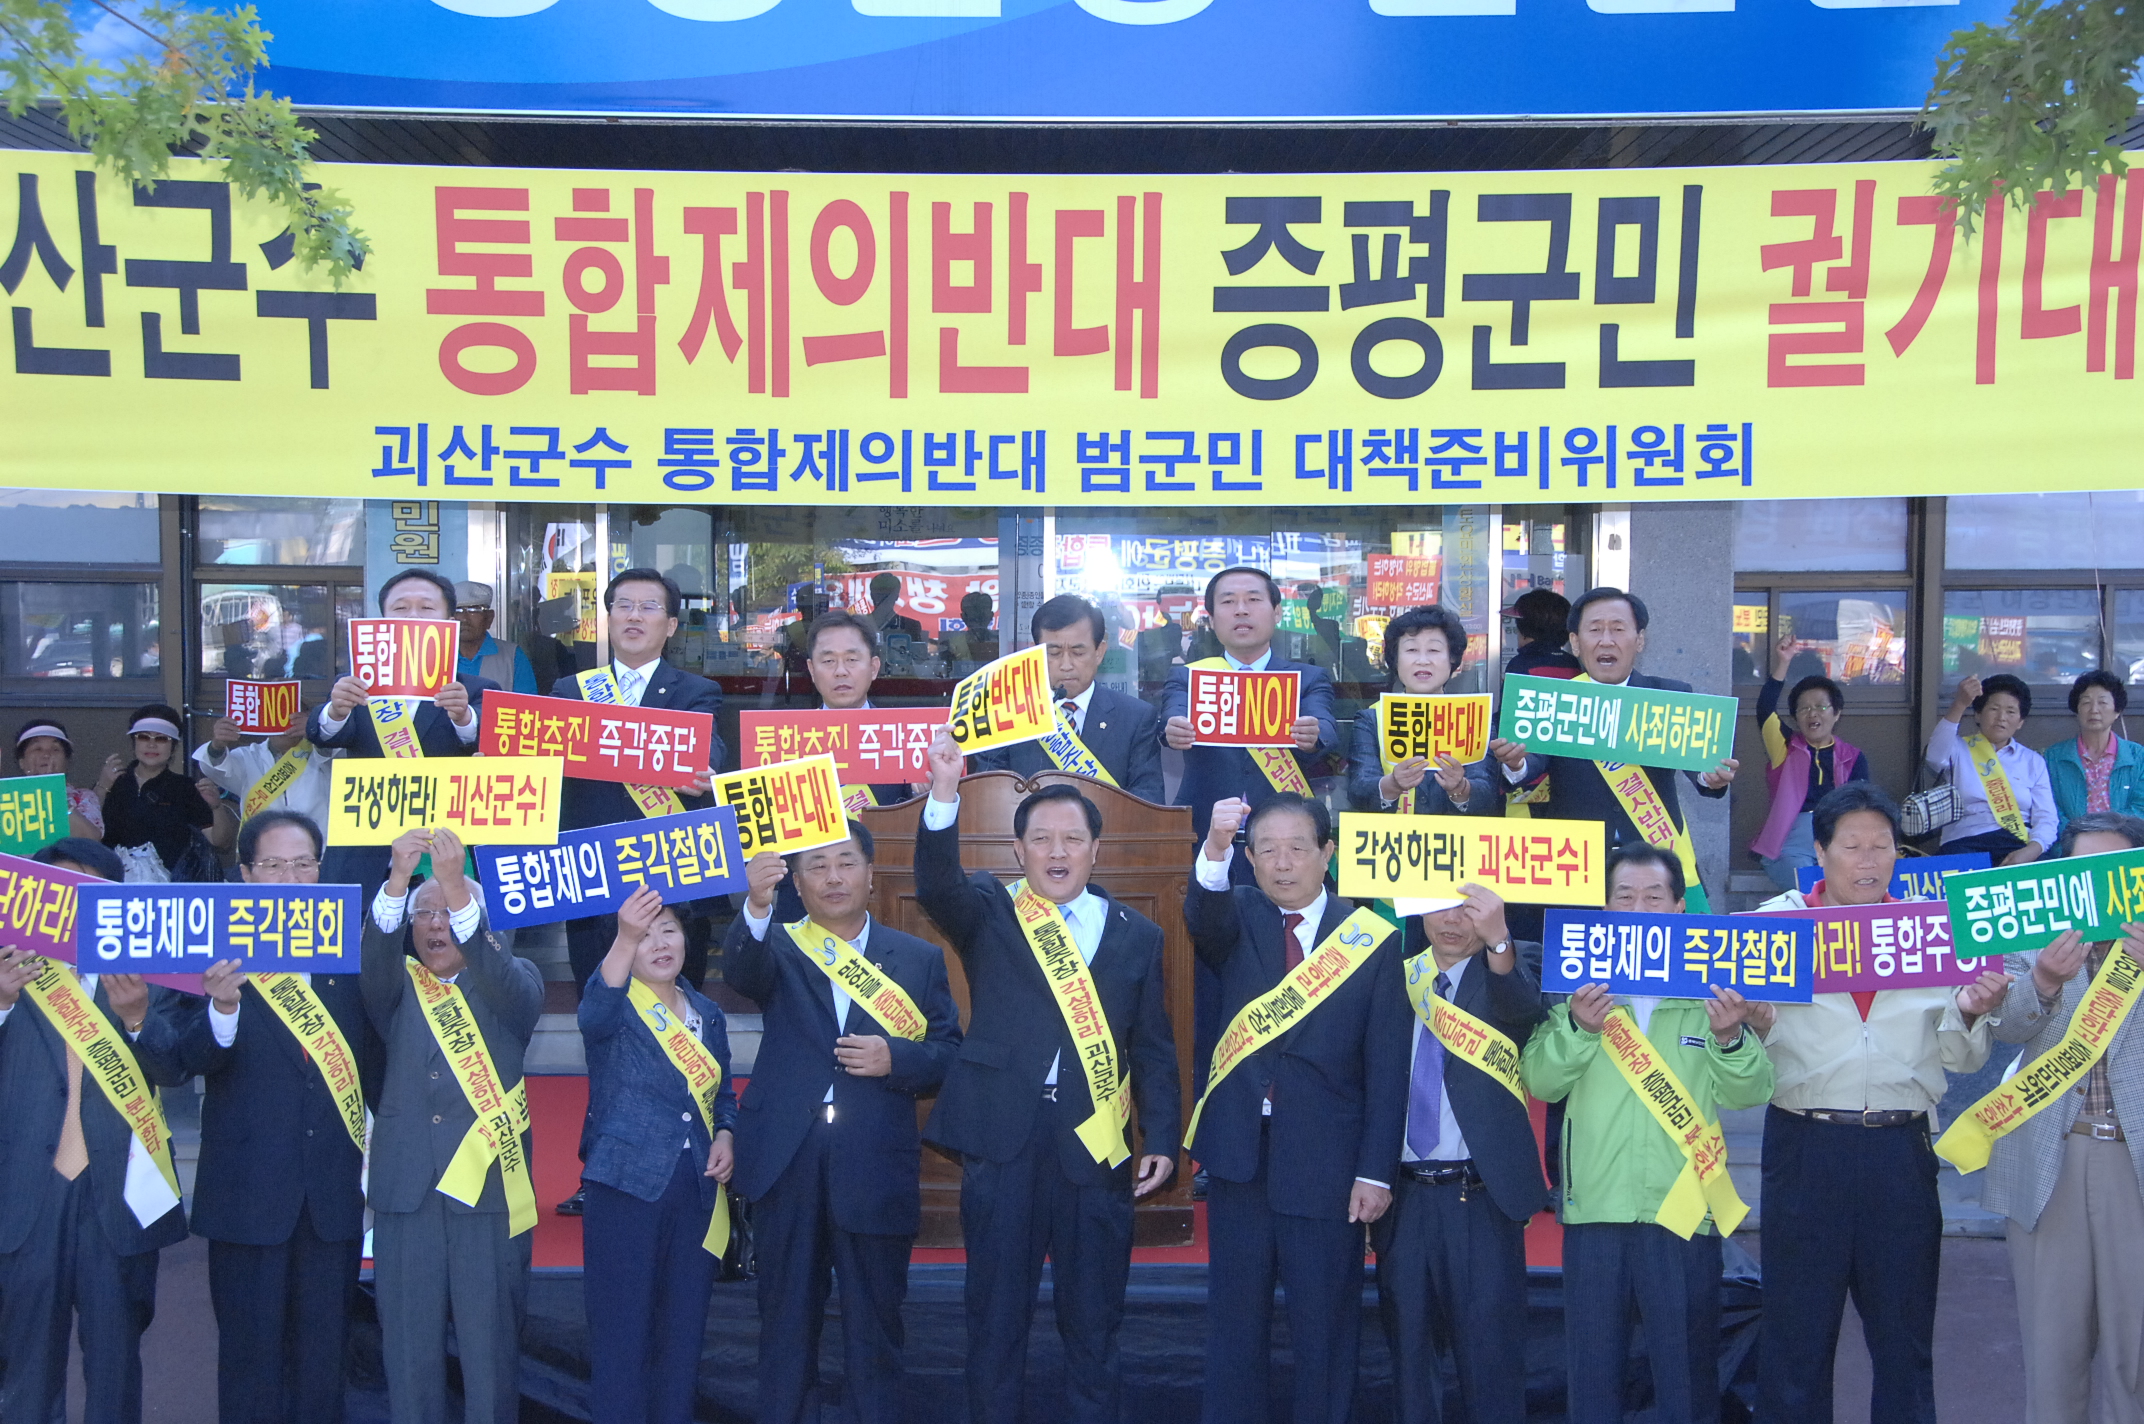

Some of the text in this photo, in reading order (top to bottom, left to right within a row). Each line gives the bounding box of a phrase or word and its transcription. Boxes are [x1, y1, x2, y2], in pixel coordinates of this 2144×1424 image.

[0, 169, 2144, 401] 산군수 통합제의반대 증평군민 궐기대
[372, 423, 1754, 493] 괴산군수 통합제의반대 범군민 대책준비위원회
[355, 623, 397, 688] 통합
[231, 684, 261, 728] 통합
[952, 656, 1045, 744] 통합반대!
[1195, 674, 1241, 737] 통합
[1388, 701, 1484, 760] 통합반대!
[1513, 688, 1723, 760] 증평군민에 사죄하라!
[494, 706, 697, 773] 통합추진 즉각중단
[263, 760, 298, 795] 증평민심
[343, 773, 547, 830] 각성하라! 괴산군수!
[494, 821, 730, 915] 통합제의 즉각철회
[1354, 829, 1589, 887] 각성하라! 괴산군수!
[95, 897, 344, 961] 통합제의 즉각철회
[1964, 869, 2100, 943] 증평군민에
[1559, 922, 1797, 988] 통합제의 즉각철회
[838, 958, 927, 1041] 망언을 중단하고
[1033, 921, 1078, 980] 통합주장
[1060, 977, 1105, 1039] 각성하라
[1084, 1042, 1118, 1102] 괴산군수
[1218, 946, 1351, 1071] 중단하라 통합주장 각성하라
[1432, 1003, 1488, 1057] 중단하라
[2075, 987, 2125, 1048] 중단하고
[47, 986, 98, 1042] 통합주장
[89, 1038, 137, 1098] 증평군민
[271, 977, 324, 1037] 통합주장
[314, 1031, 363, 1092] 각성하라
[670, 1025, 719, 1088] 중단하라
[432, 998, 475, 1054] 통합주장
[460, 1051, 507, 1112] 각성하라
[491, 1113, 521, 1173] 괴산군수
[1599, 1015, 1652, 1075] 통합주장
[1642, 1070, 1693, 1129] 증평군민
[1976, 1087, 2024, 1138] 사죄하라
